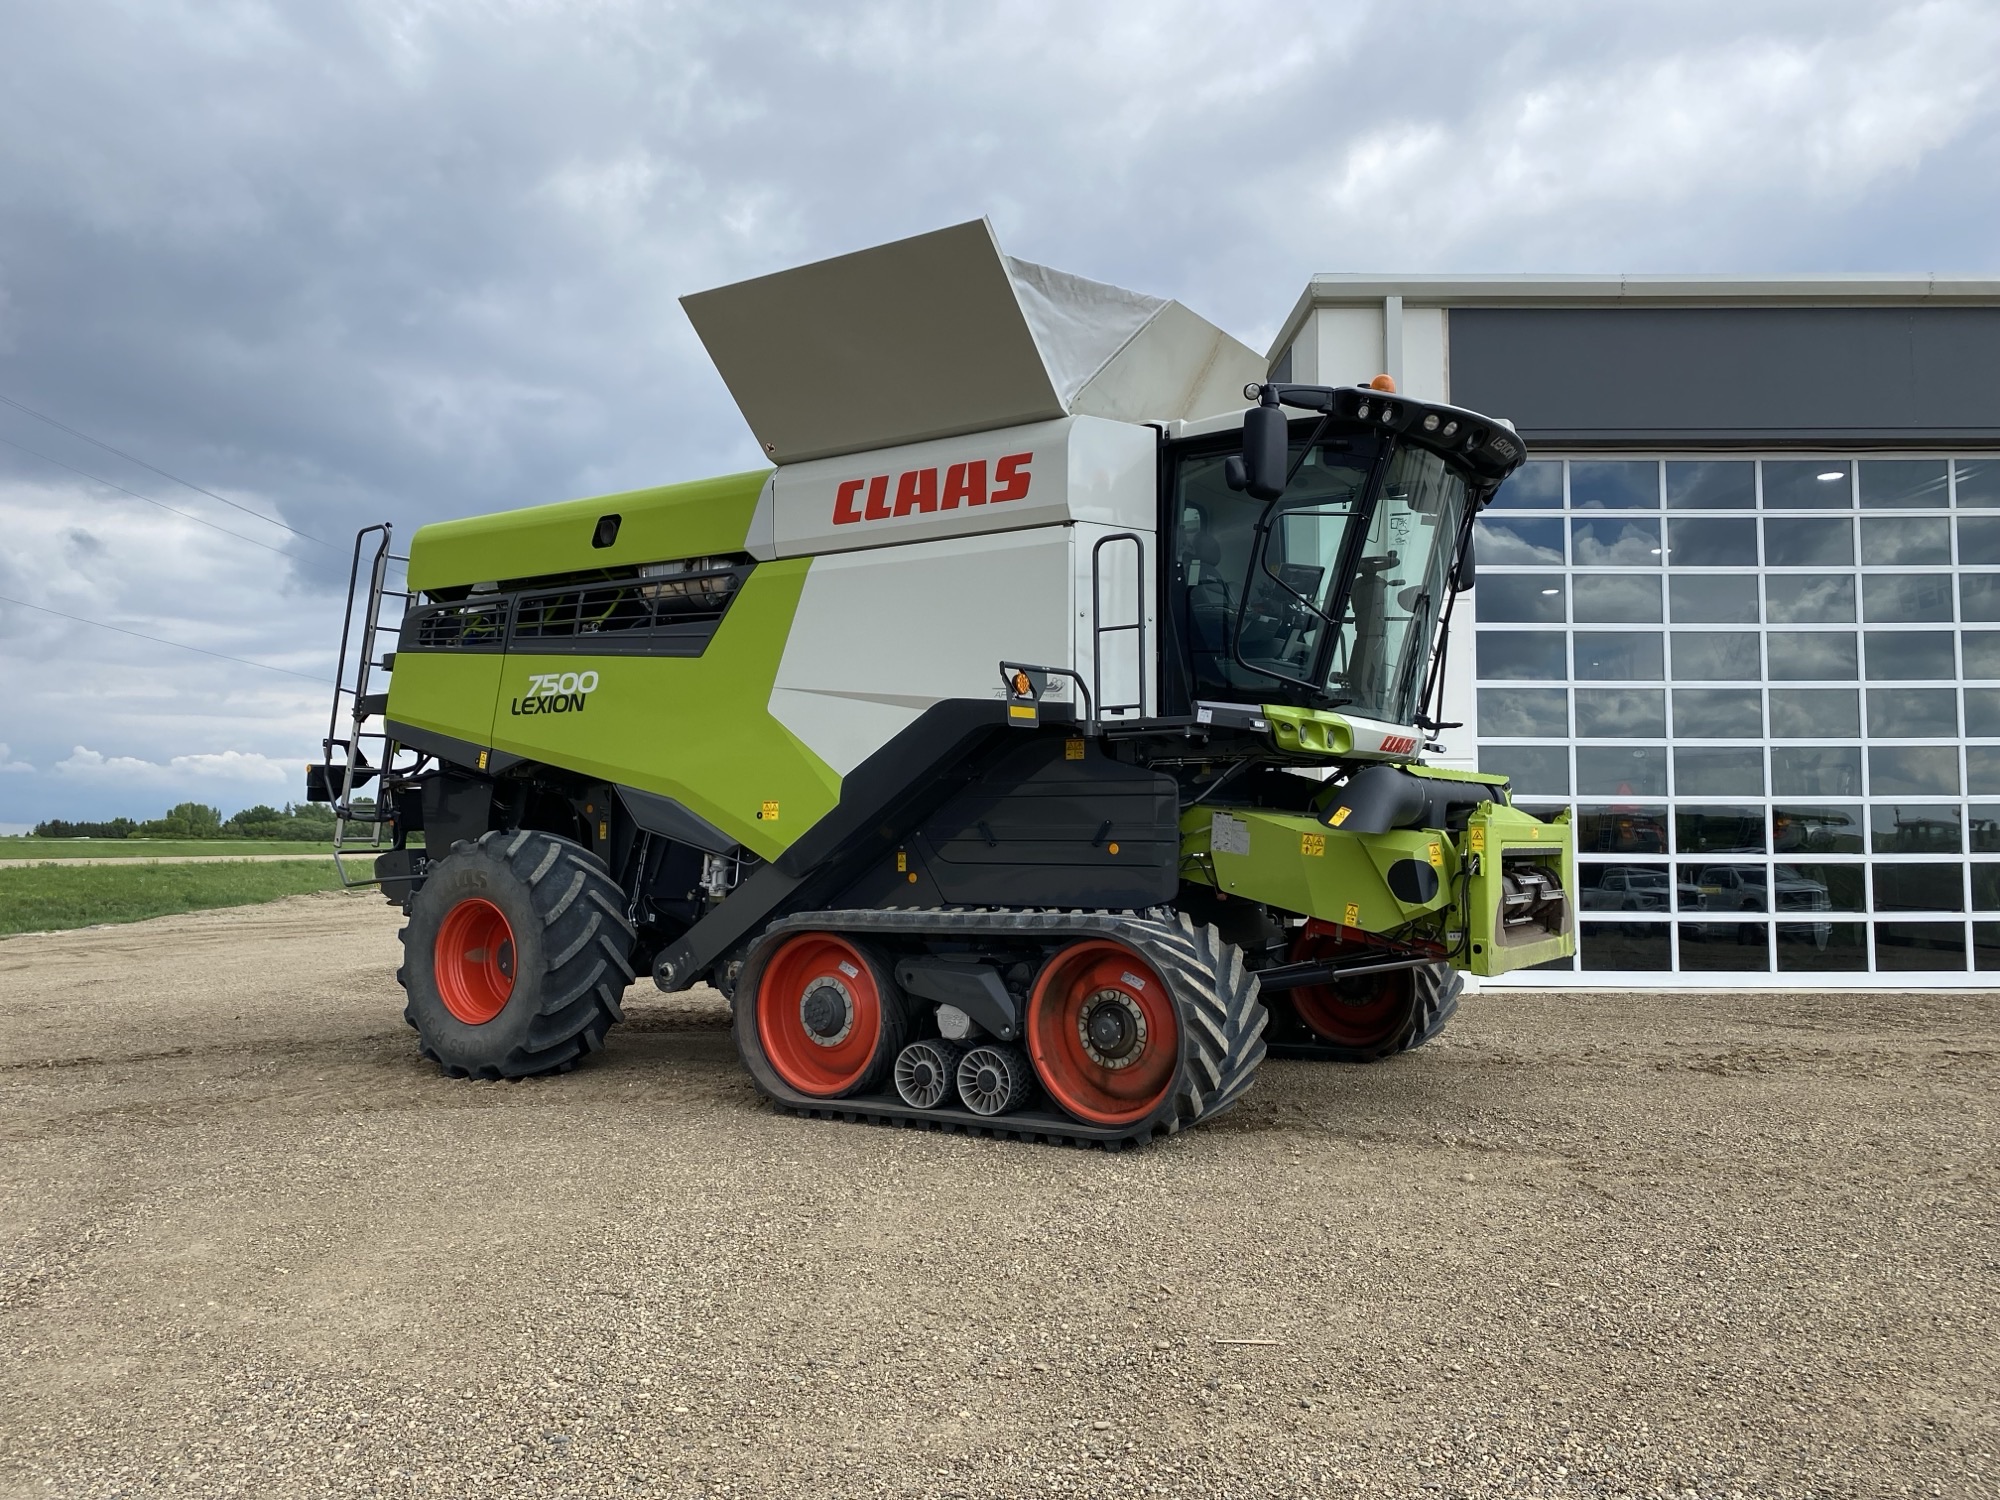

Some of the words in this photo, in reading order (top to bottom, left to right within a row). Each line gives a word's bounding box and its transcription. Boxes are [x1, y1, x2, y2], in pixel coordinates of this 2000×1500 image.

[1490, 435, 1518, 460] LEXION
[832, 451, 1034, 526] CLAAS
[526, 670, 599, 698] 7500
[511, 693, 587, 716] LEXION
[1379, 735, 1418, 755] CLAAS
